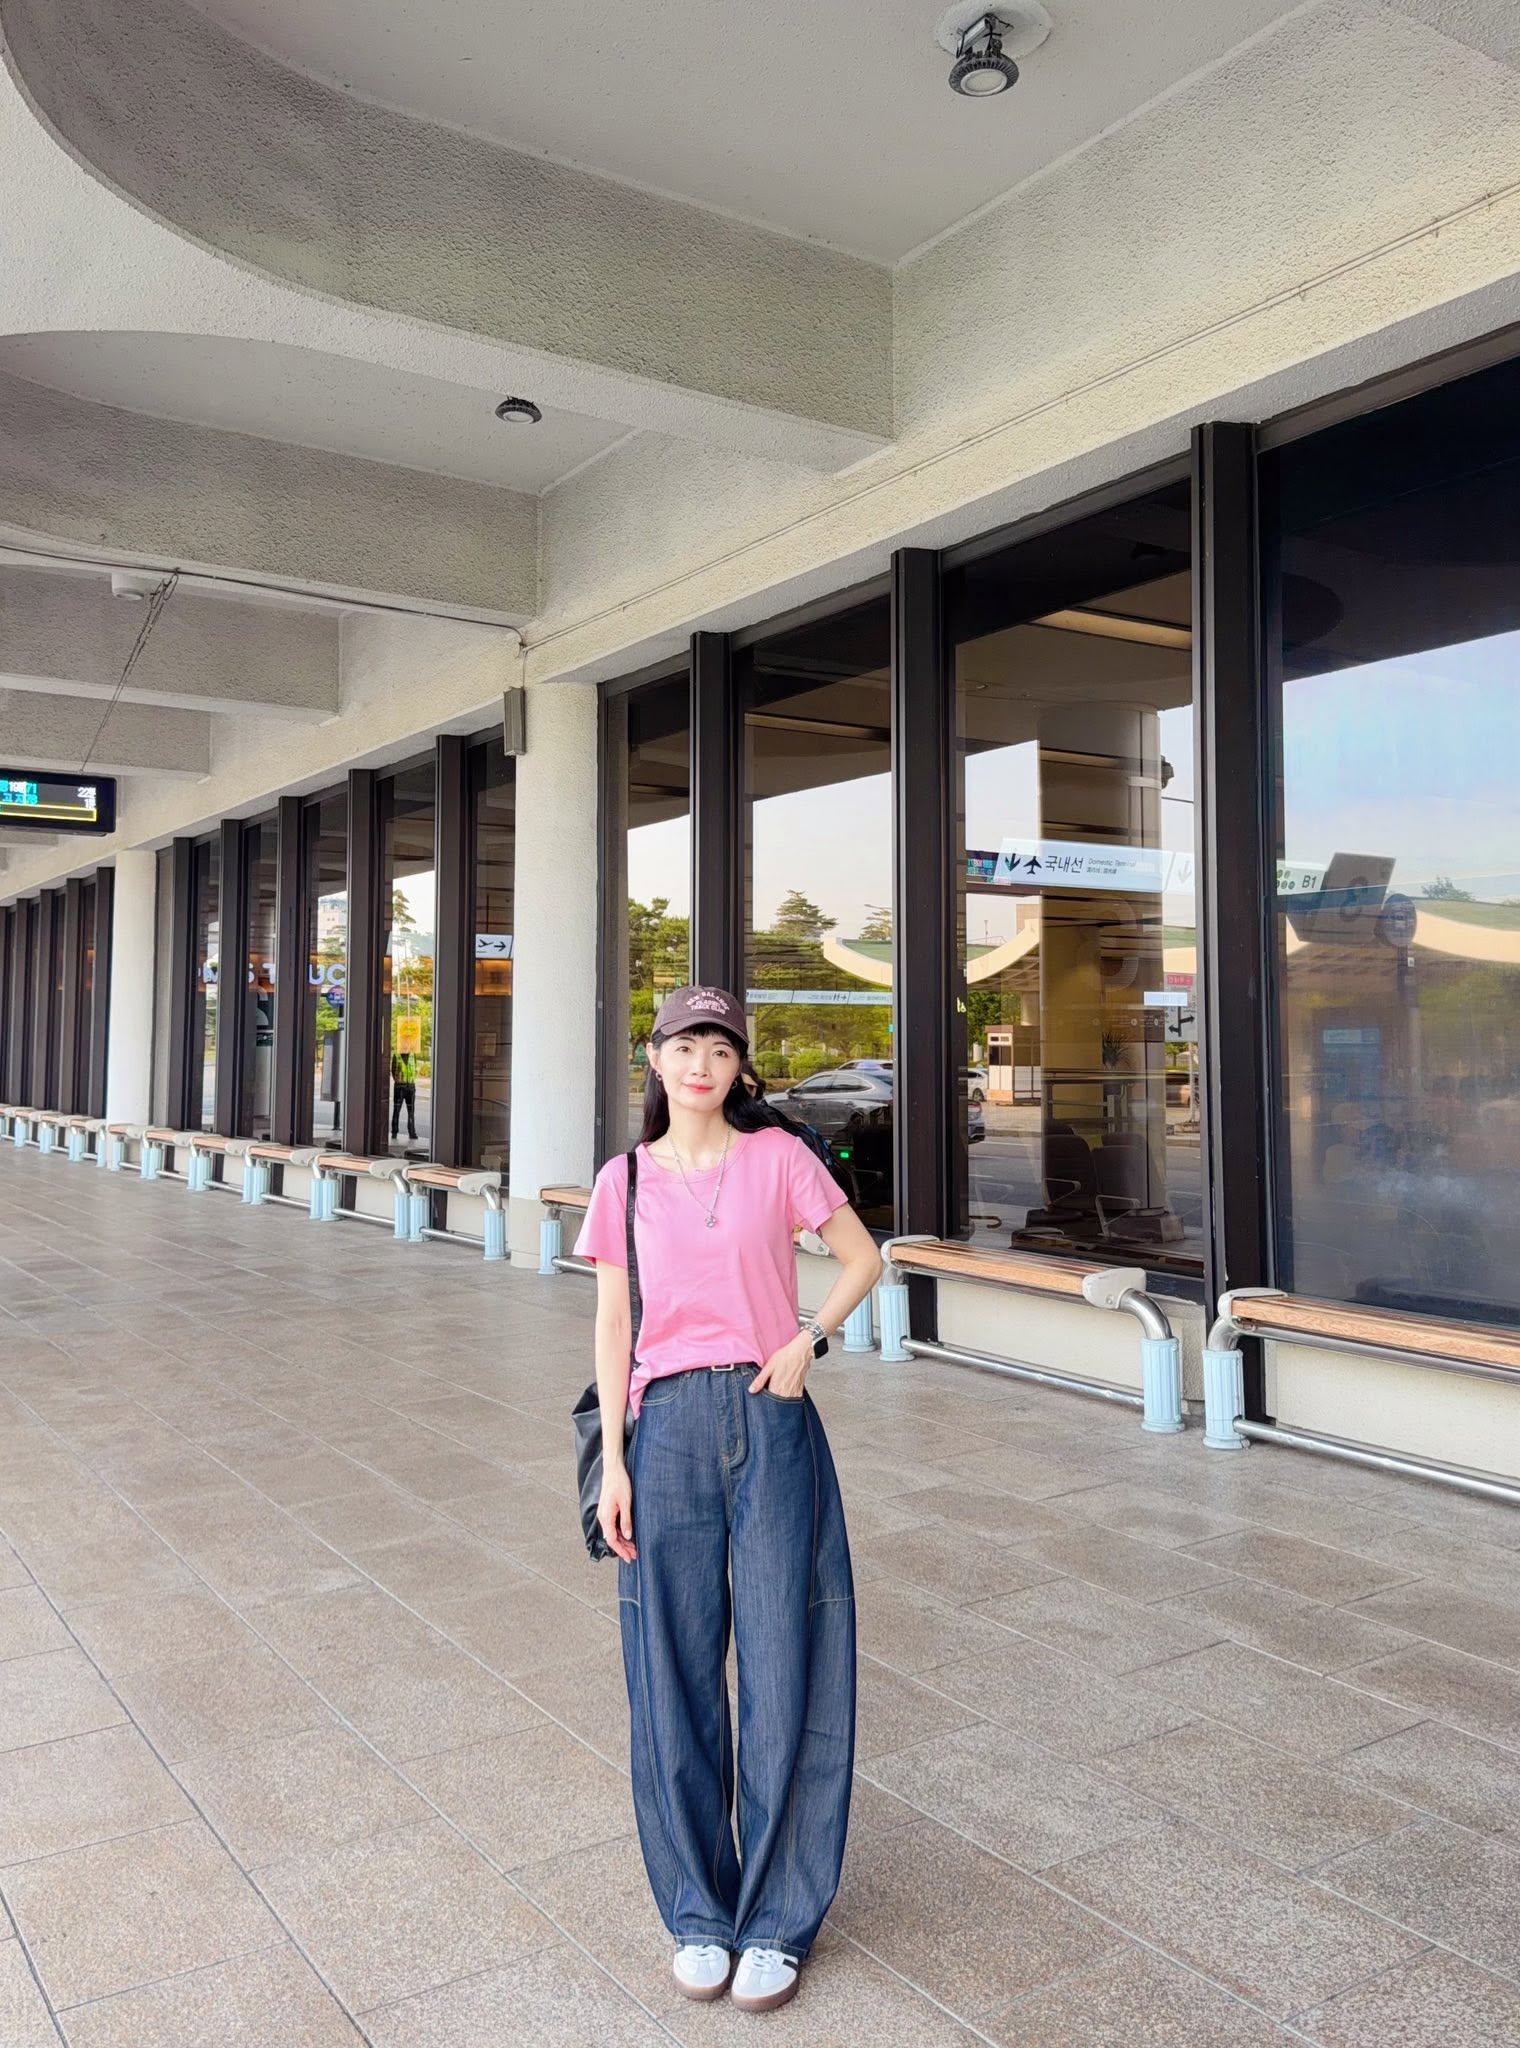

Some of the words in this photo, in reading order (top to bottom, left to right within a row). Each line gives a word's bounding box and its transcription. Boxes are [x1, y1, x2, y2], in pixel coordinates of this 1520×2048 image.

[1045, 855, 1084, 874] 국내선
[1088, 857, 1113, 867] Domestic
[1301, 875, 1317, 889] B1
[686, 995, 700, 1006] NEW
[701, 991, 730, 1011] BALANCE
